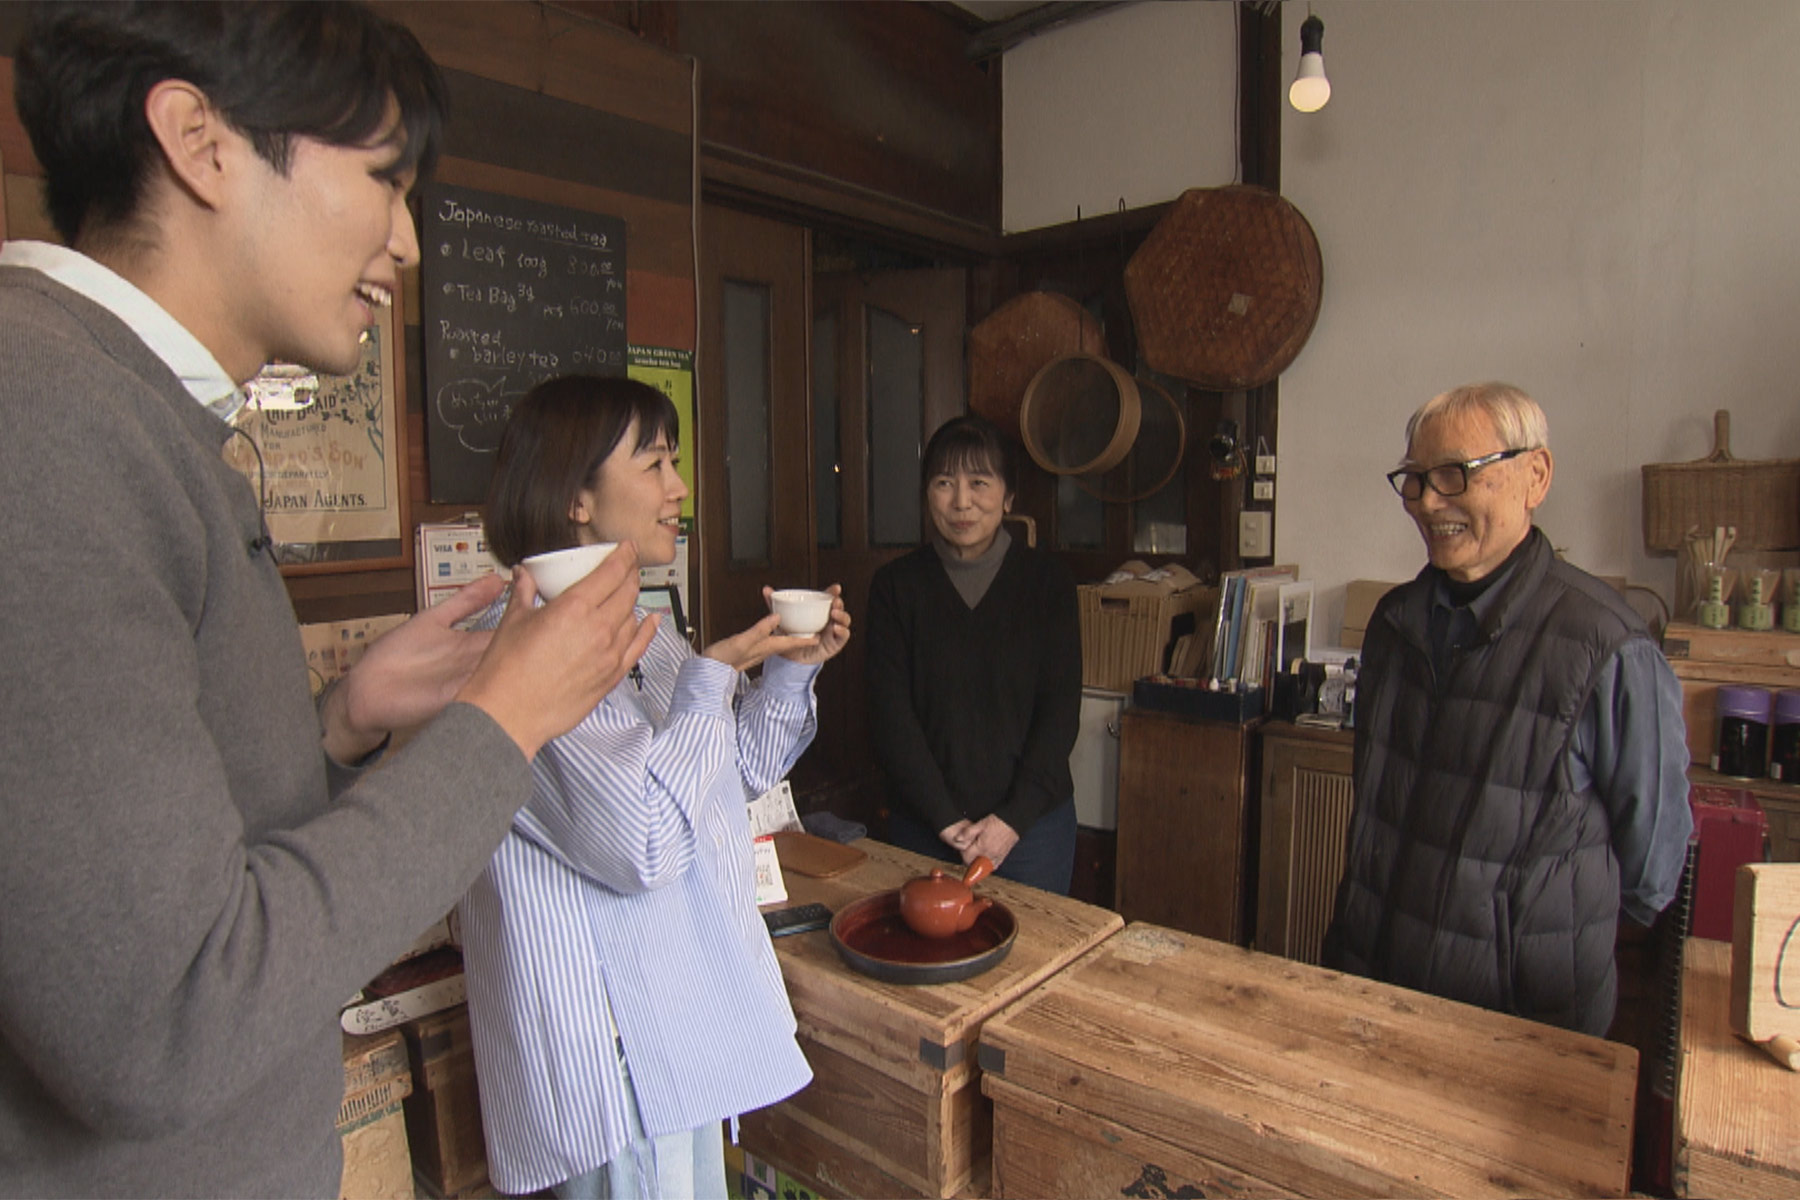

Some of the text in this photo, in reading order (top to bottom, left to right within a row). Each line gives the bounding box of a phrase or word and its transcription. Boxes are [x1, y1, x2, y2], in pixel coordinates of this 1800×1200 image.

[439, 200, 523, 230] Japanese
[462, 238, 506, 268] Leaf
[457, 284, 482, 301] Tea
[489, 287, 517, 312] Bag
[472, 346, 526, 373] barley
[265, 490, 367, 508] JAPAN AGENTS.
[434, 543, 453, 552] VISA
